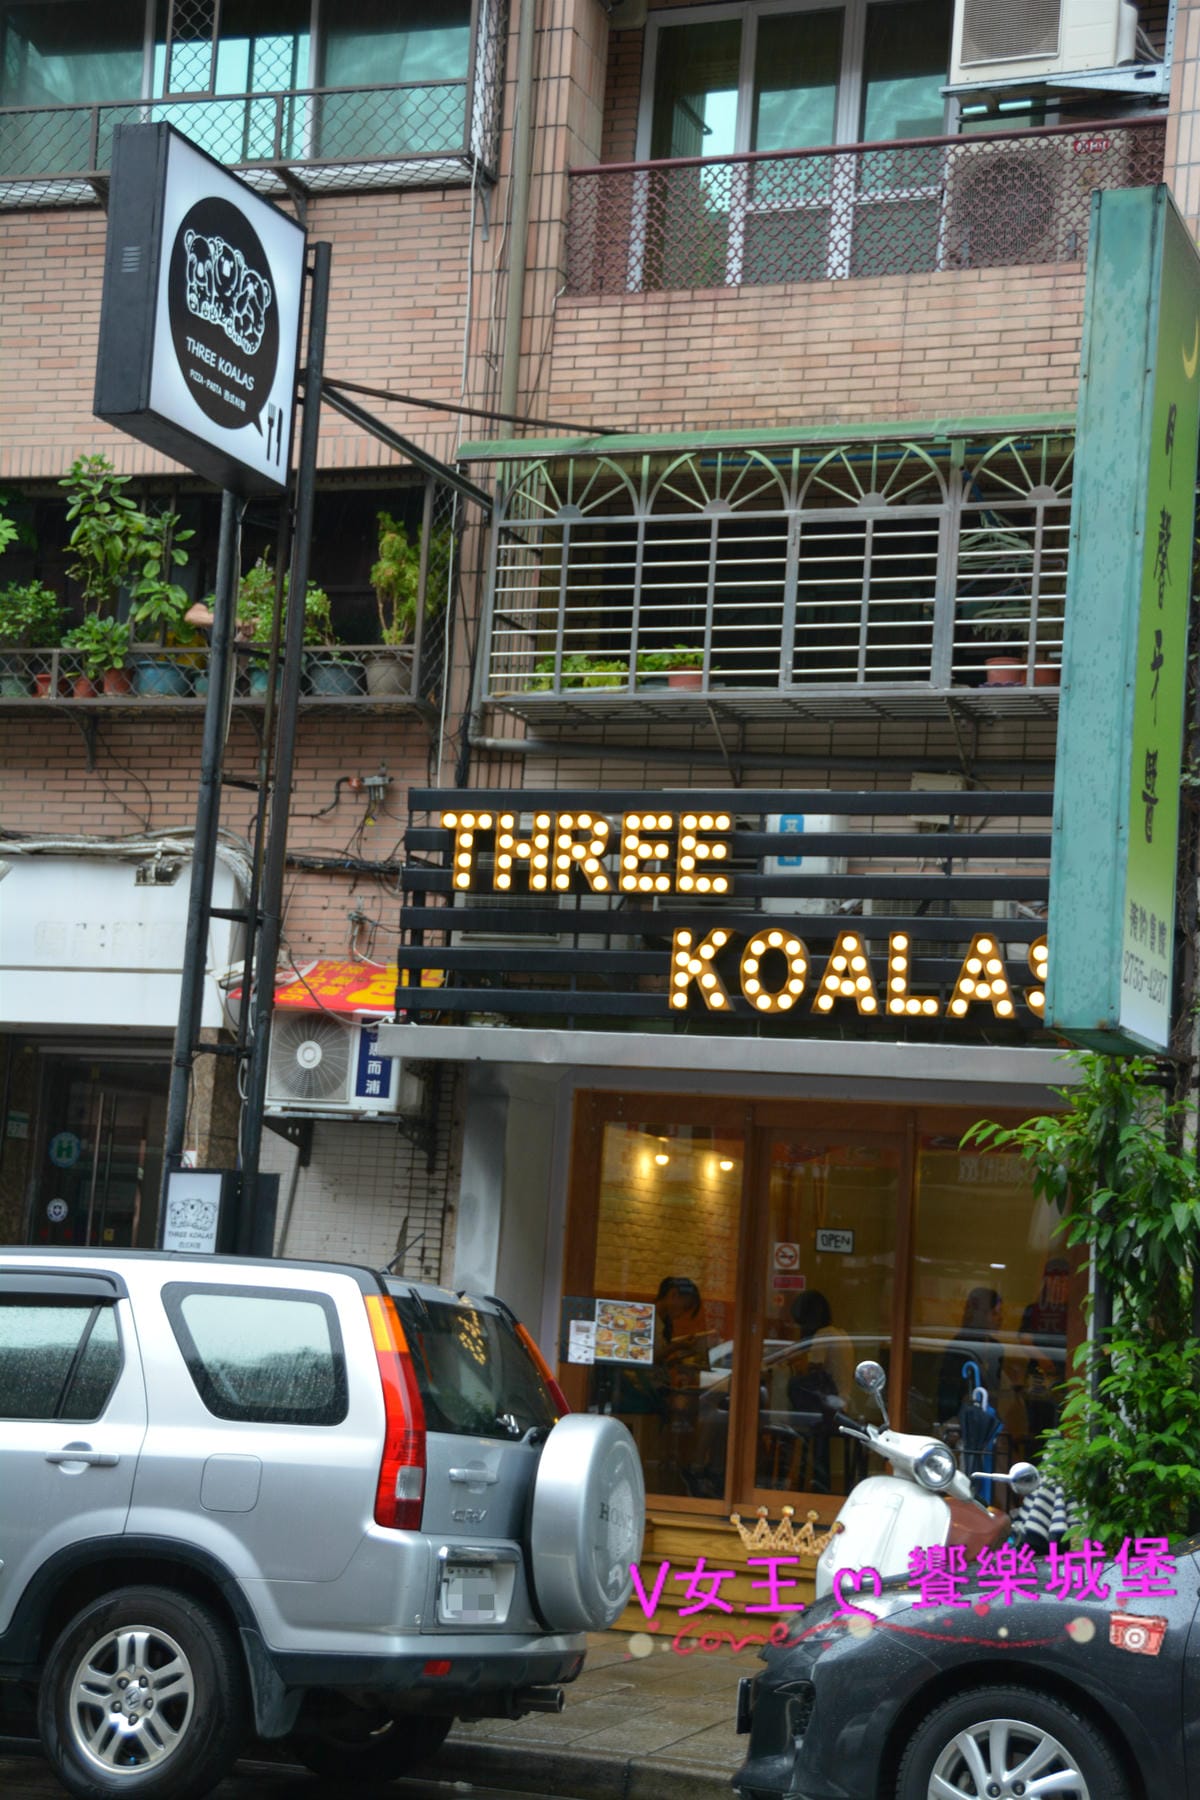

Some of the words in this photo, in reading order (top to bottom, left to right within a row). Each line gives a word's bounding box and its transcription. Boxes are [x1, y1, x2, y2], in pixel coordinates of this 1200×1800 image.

[185, 336, 217, 368] THREE
[217, 357, 255, 391] KOALAS
[440, 809, 736, 894] THREE
[820, 1233, 851, 1249] OPEN
